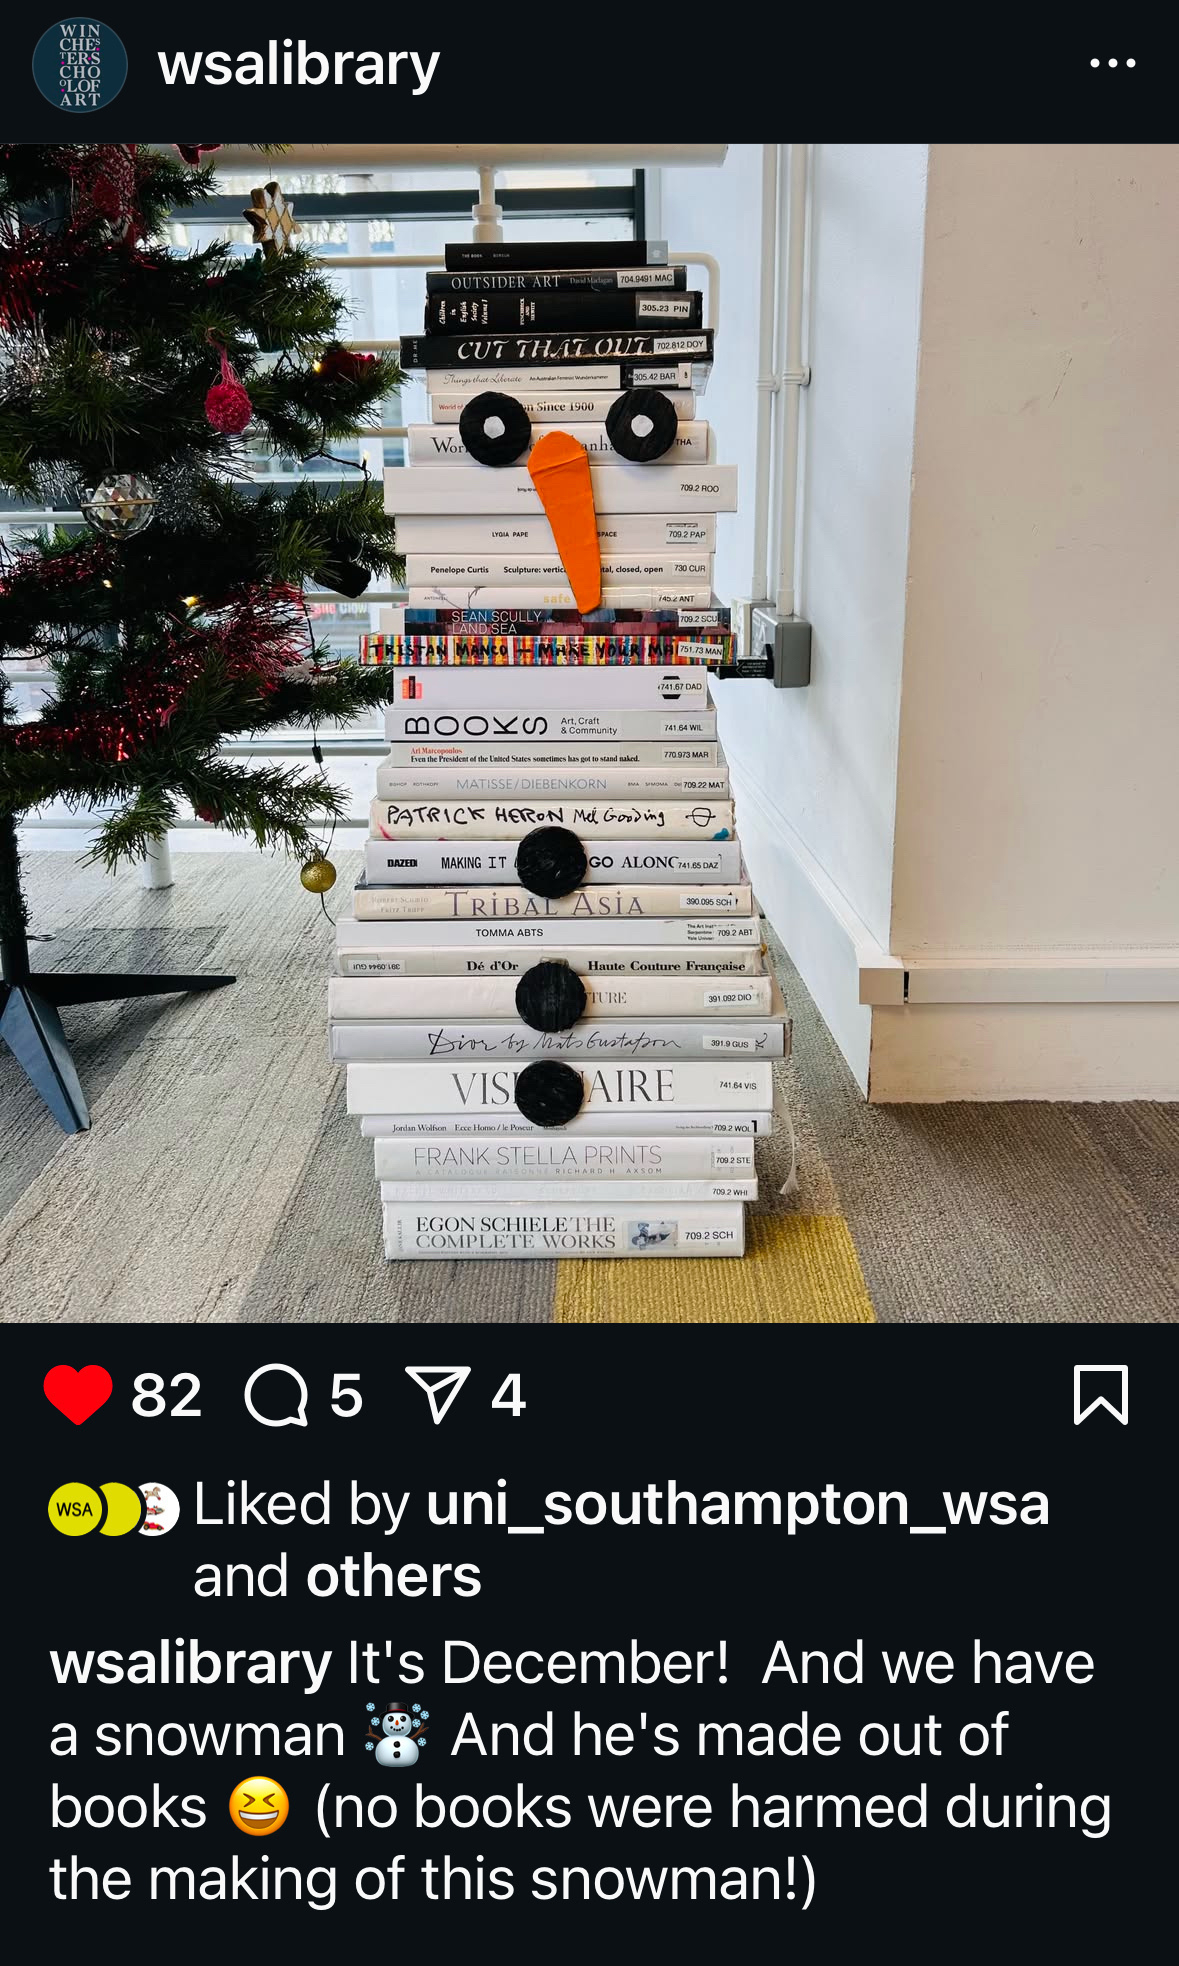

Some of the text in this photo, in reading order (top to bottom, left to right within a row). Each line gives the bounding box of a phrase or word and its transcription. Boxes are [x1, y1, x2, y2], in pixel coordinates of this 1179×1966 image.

[451, 274, 561, 290] OUTSIDER ART
[620, 274, 673, 284] 704.9491 MAC
[641, 304, 689, 313] 305.23 PIN
[457, 336, 651, 360] CUT THAT OUT
[656, 340, 704, 350] 702.812 DOY
[443, 372, 523, 387] Things that Liberate
[634, 373, 658, 381] 305.42
[659, 372, 676, 380] BAR
[536, 401, 566, 412] Since
[569, 401, 594, 412] 1900
[680, 484, 720, 493] 709.2 ROO
[668, 530, 706, 539] 709.2 PAP
[430, 566, 465, 575] Penelope
[467, 566, 489, 574] Curtis
[503, 566, 541, 575] Sculpture:
[616, 566, 642, 575] closed,
[643, 567, 664, 575] open
[674, 564, 706, 573] 730 CUR
[544, 593, 571, 603] safe
[451, 610, 542, 623] SEAN SCULLY
[451, 623, 517, 635] LAND SEA
[369, 643, 640, 658] TRISTAN MANCO MAKE YOUR
[679, 645, 722, 656] 751.73 MAN
[405, 715, 548, 736] BOOKS
[560, 717, 600, 726] Art, Craft
[560, 727, 618, 736] & Community
[664, 724, 688, 732] 741.64
[422, 747, 463, 756] Marcopoulos
[664, 751, 691, 759] 770.973
[568, 755, 579, 763] has
[580, 756, 591, 764] got
[456, 778, 607, 790] MATISSE/DIEBENKORN
[683, 781, 707, 789] 709.22
[387, 804, 563, 827] PATRICK HERON
[573, 807, 665, 827] Mel Gooding
[387, 858, 418, 868] DAZED
[441, 856, 507, 869] MAKING IT
[589, 856, 614, 868] GO
[686, 898, 732, 906] 390.095 SCH
[476, 928, 544, 937] TOMMA ABTS
[466, 960, 485, 971] Dé
[588, 960, 746, 973] Haute Couture Française
[428, 1028, 497, 1056] Dior
[501, 1033, 529, 1053] by
[711, 1039, 749, 1049] 391.9 GUS
[451, 1069, 675, 1106] VISAIRE
[719, 1081, 757, 1090] 741.64 VIS
[392, 1124, 447, 1133] Jordan Wolfson
[454, 1124, 472, 1132] Ecce
[473, 1124, 496, 1132] Homo
[414, 1145, 662, 1166] FRANK STELLA PRINTS
[556, 1167, 603, 1175] RICHARD
[416, 1216, 615, 1232] EGON SCHIELE THE
[685, 1231, 734, 1240] 709.2 SCH
[416, 1234, 535, 1249] COMPLETE
[542, 1234, 616, 1249] WORKS
